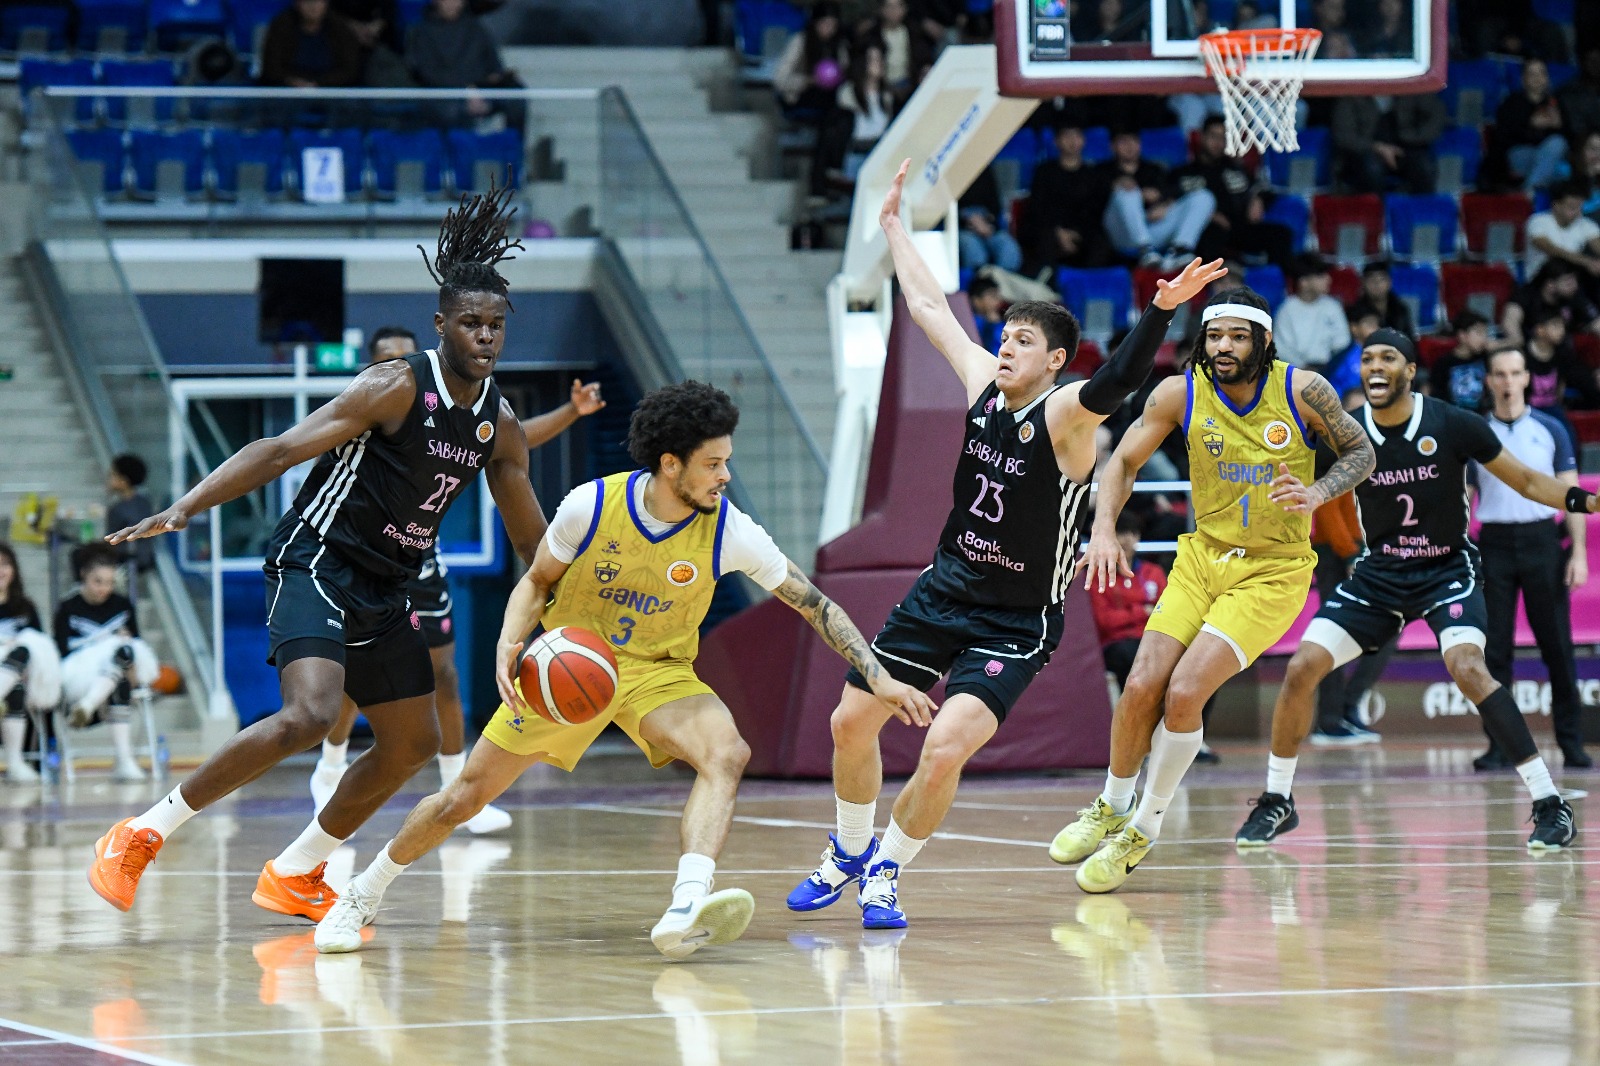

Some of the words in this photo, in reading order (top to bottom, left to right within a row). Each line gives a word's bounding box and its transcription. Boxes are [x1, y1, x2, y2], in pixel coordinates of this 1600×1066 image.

[427, 439, 467, 464] SABAH
[467, 451, 482, 468] BC
[1005, 457, 1026, 475] BC
[1369, 467, 1415, 487] SABAH
[1418, 464, 1440, 480] BC
[419, 473, 460, 513] 27
[969, 473, 1005, 522] 23
[1239, 494, 1250, 528] 1
[1396, 493, 1419, 527] 2
[406, 522, 433, 537] Bank
[964, 531, 1002, 554] Bank
[1398, 534, 1430, 546] Bank
[1383, 543, 1451, 559] Respublika
[610, 616, 637, 646] 3
